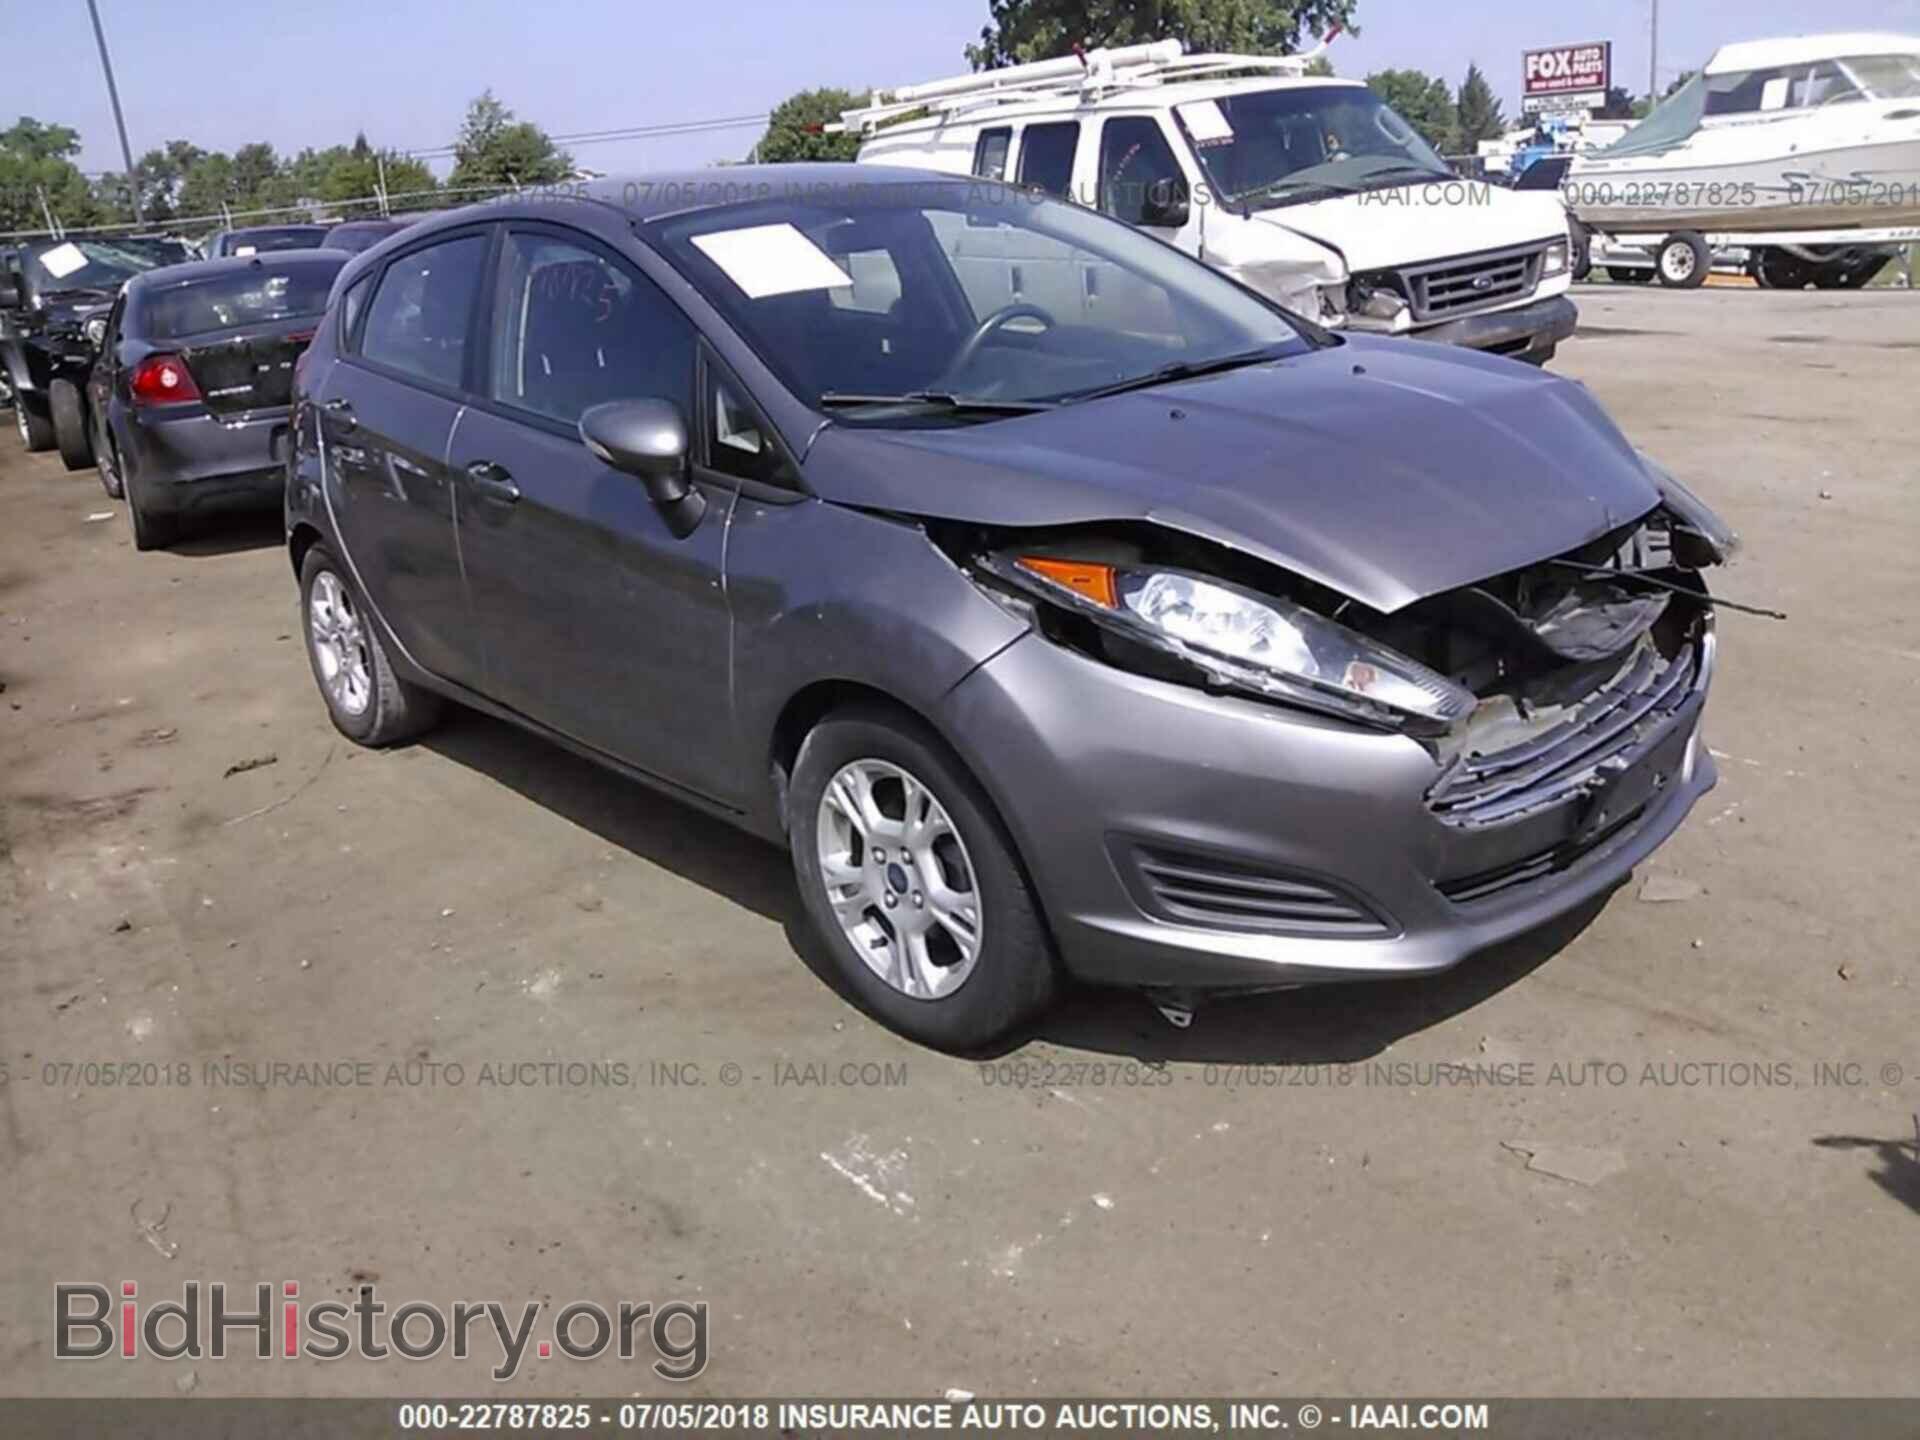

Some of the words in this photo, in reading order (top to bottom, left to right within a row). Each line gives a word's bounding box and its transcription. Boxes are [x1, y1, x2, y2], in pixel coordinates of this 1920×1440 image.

[1574, 48, 1600, 61] AUTO
[1527, 51, 1571, 79] FOX
[1572, 61, 1602, 74] PARTS
